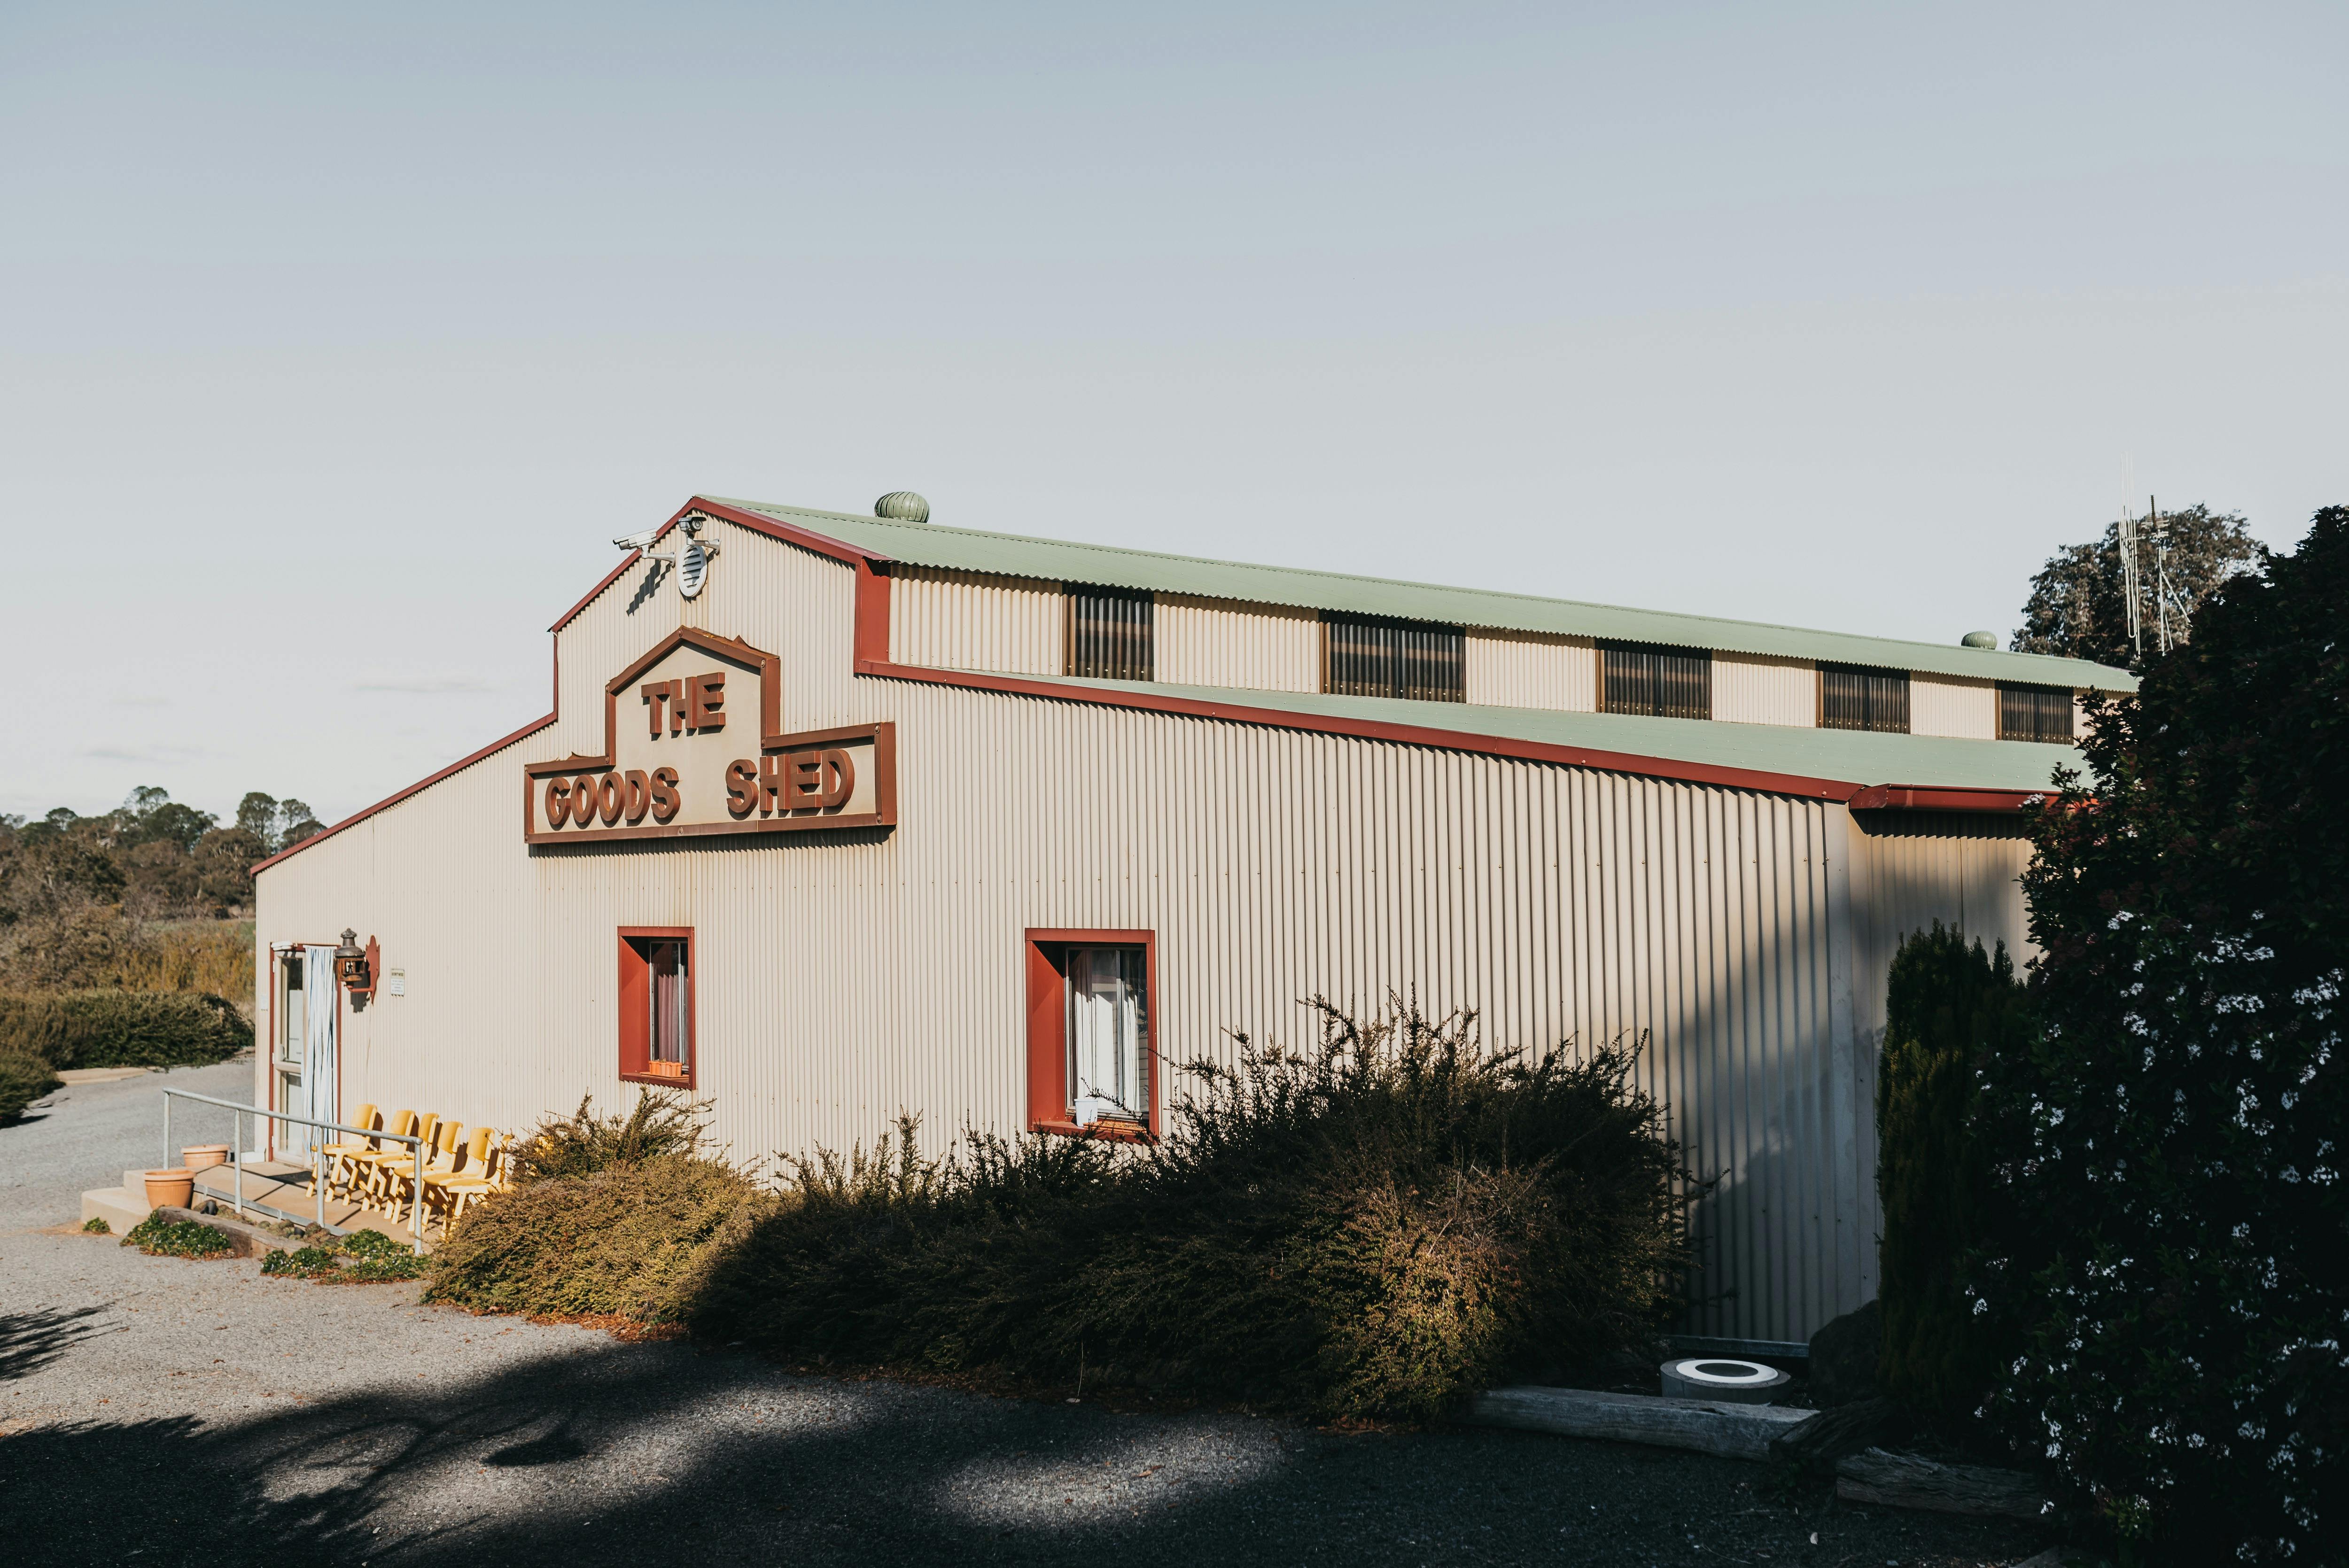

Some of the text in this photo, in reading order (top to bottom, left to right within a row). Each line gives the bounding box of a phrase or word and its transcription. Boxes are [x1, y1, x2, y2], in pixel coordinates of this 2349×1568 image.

[641, 672, 726, 734] THE
[545, 749, 855, 825] GOODS SHED
